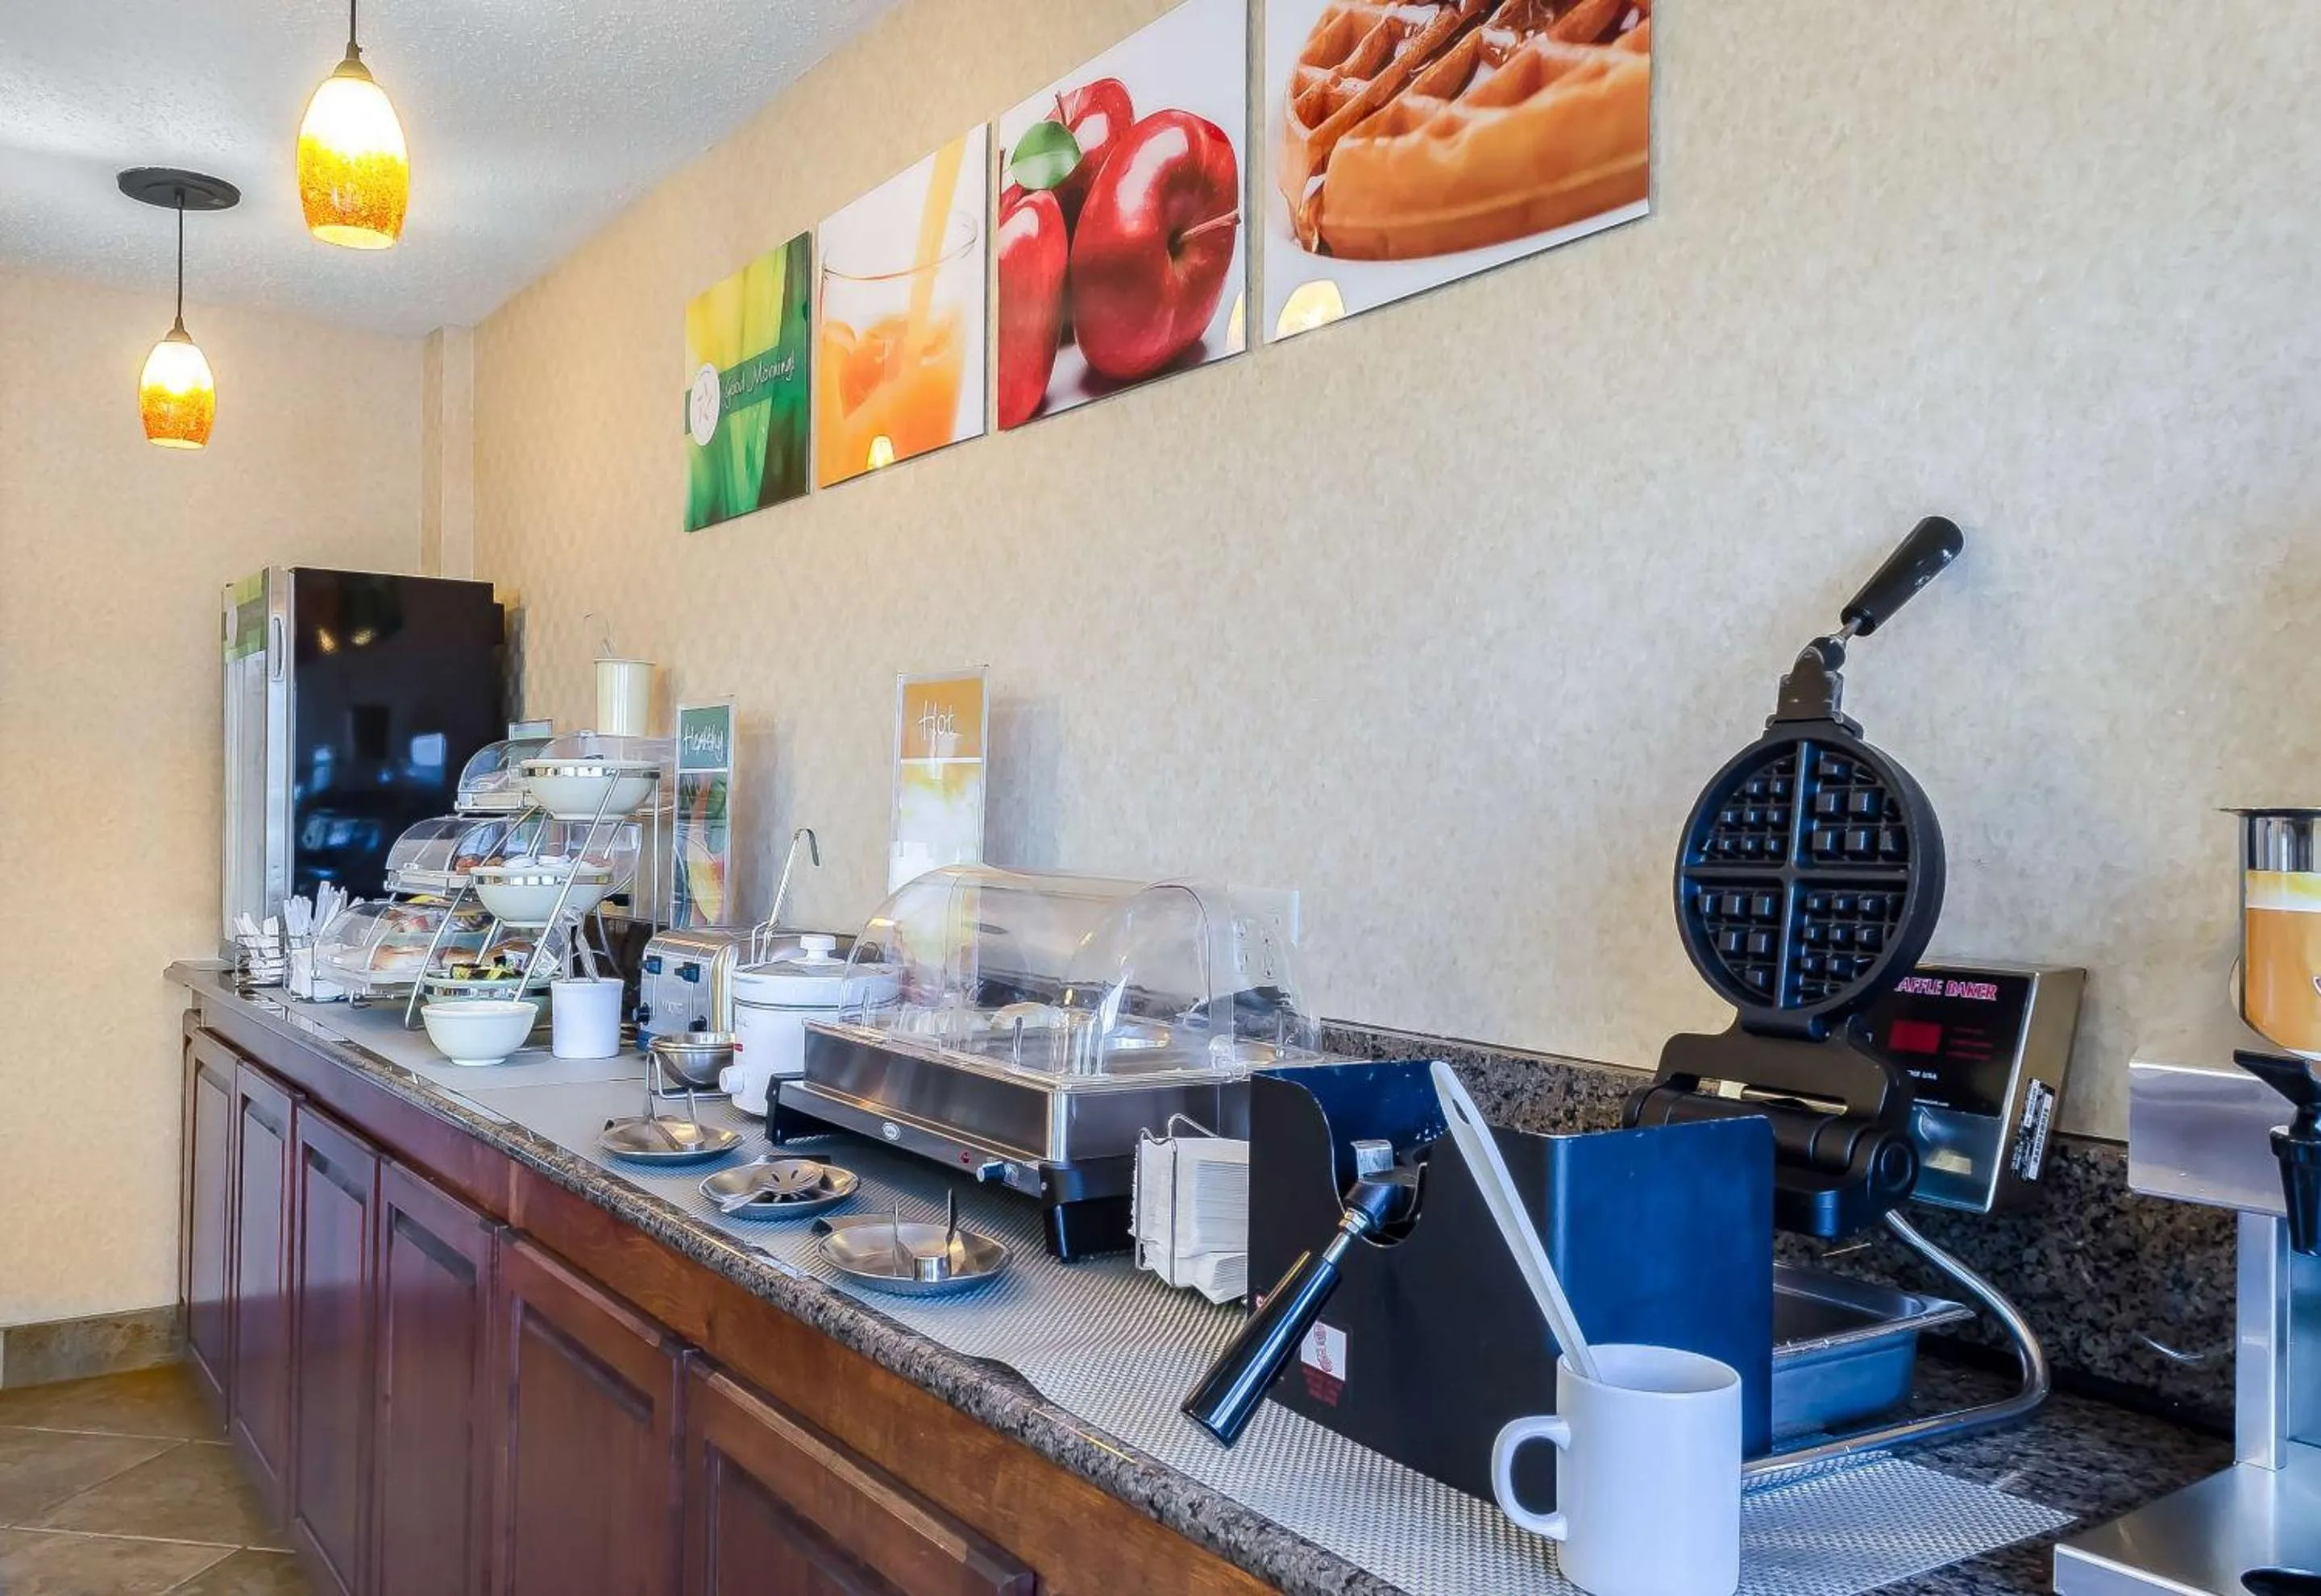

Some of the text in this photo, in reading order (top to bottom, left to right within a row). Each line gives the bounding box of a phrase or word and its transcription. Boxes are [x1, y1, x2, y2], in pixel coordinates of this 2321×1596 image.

[918, 700, 963, 740] Hot
[682, 723, 724, 762] Healthy
[1894, 977, 1997, 1001] AFFLE BAKER
